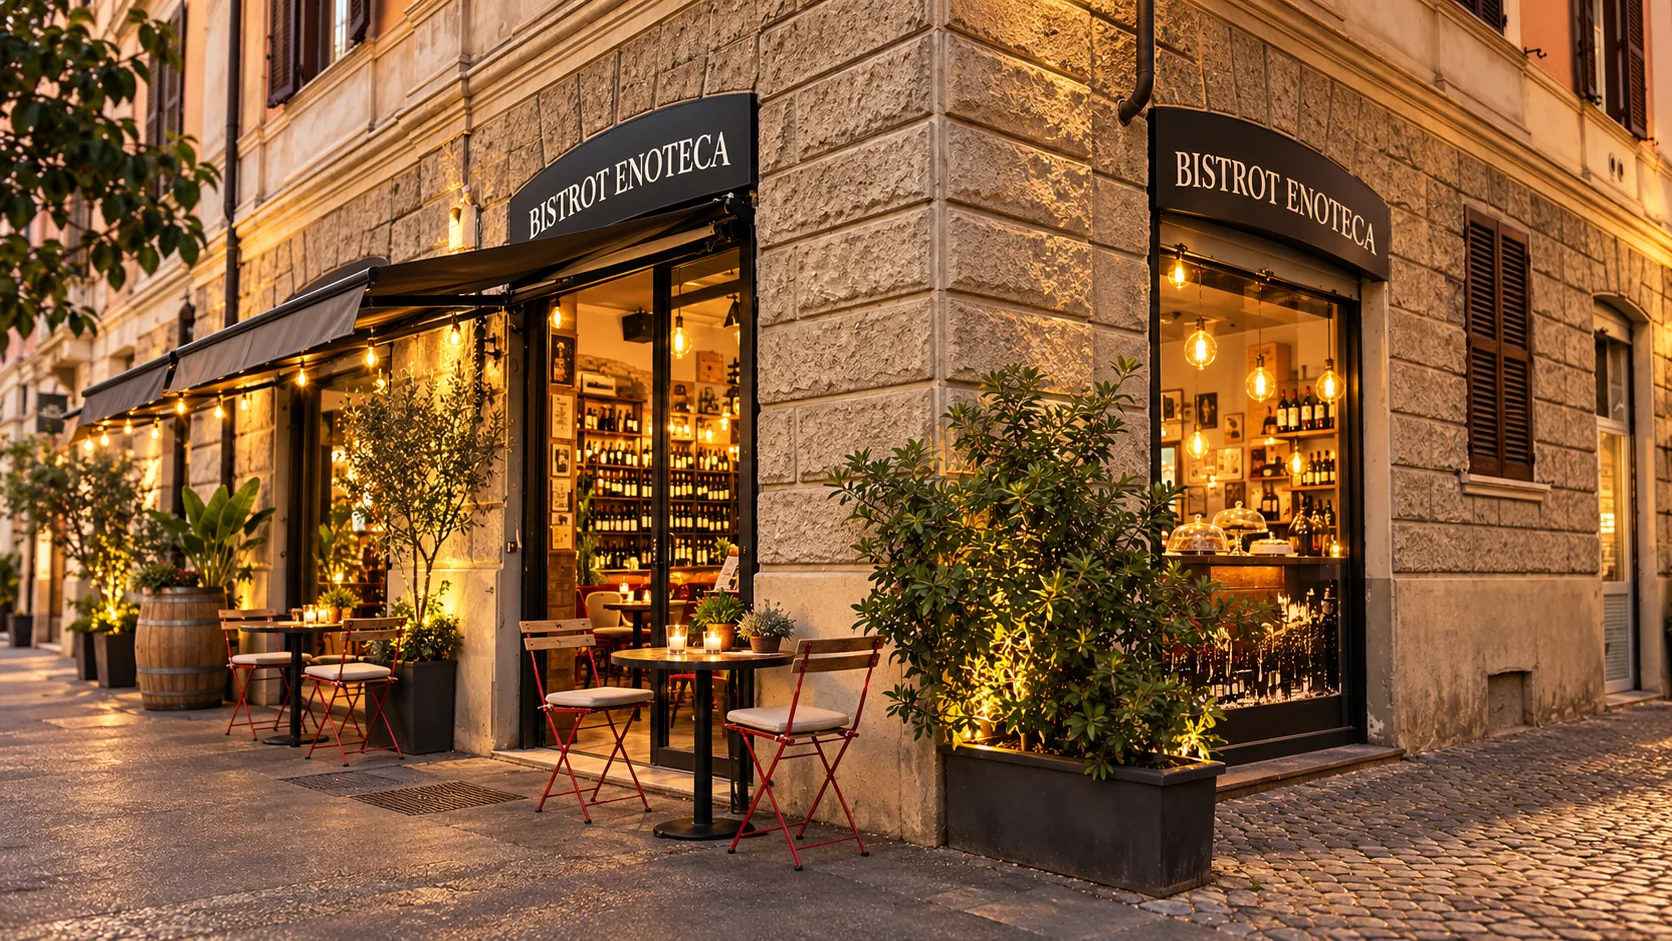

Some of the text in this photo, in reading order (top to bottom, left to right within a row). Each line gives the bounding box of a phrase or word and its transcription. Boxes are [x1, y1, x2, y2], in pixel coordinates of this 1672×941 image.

[528, 131, 731, 241] BISTROT ENOTECA
[1174, 151, 1378, 256] BISTROT ENOTECA
